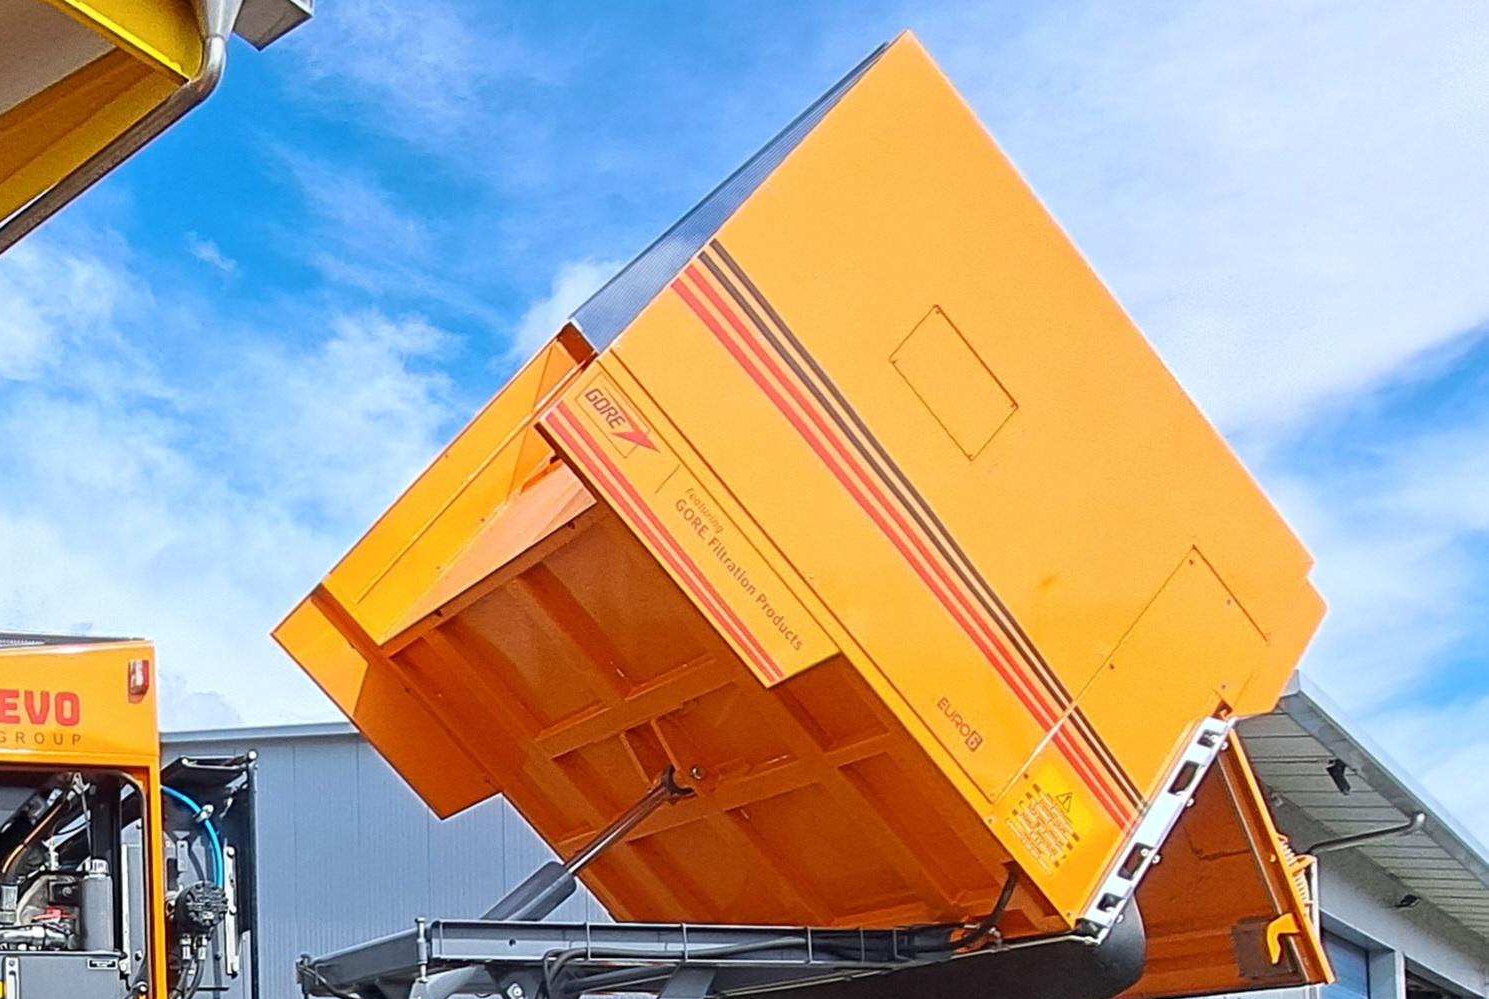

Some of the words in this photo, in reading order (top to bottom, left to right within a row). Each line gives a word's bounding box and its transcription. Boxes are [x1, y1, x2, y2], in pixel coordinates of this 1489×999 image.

[584, 388, 627, 430] GORE
[684, 486, 725, 535] Featuring
[707, 536, 758, 597] Filtration
[755, 592, 804, 652] Products
